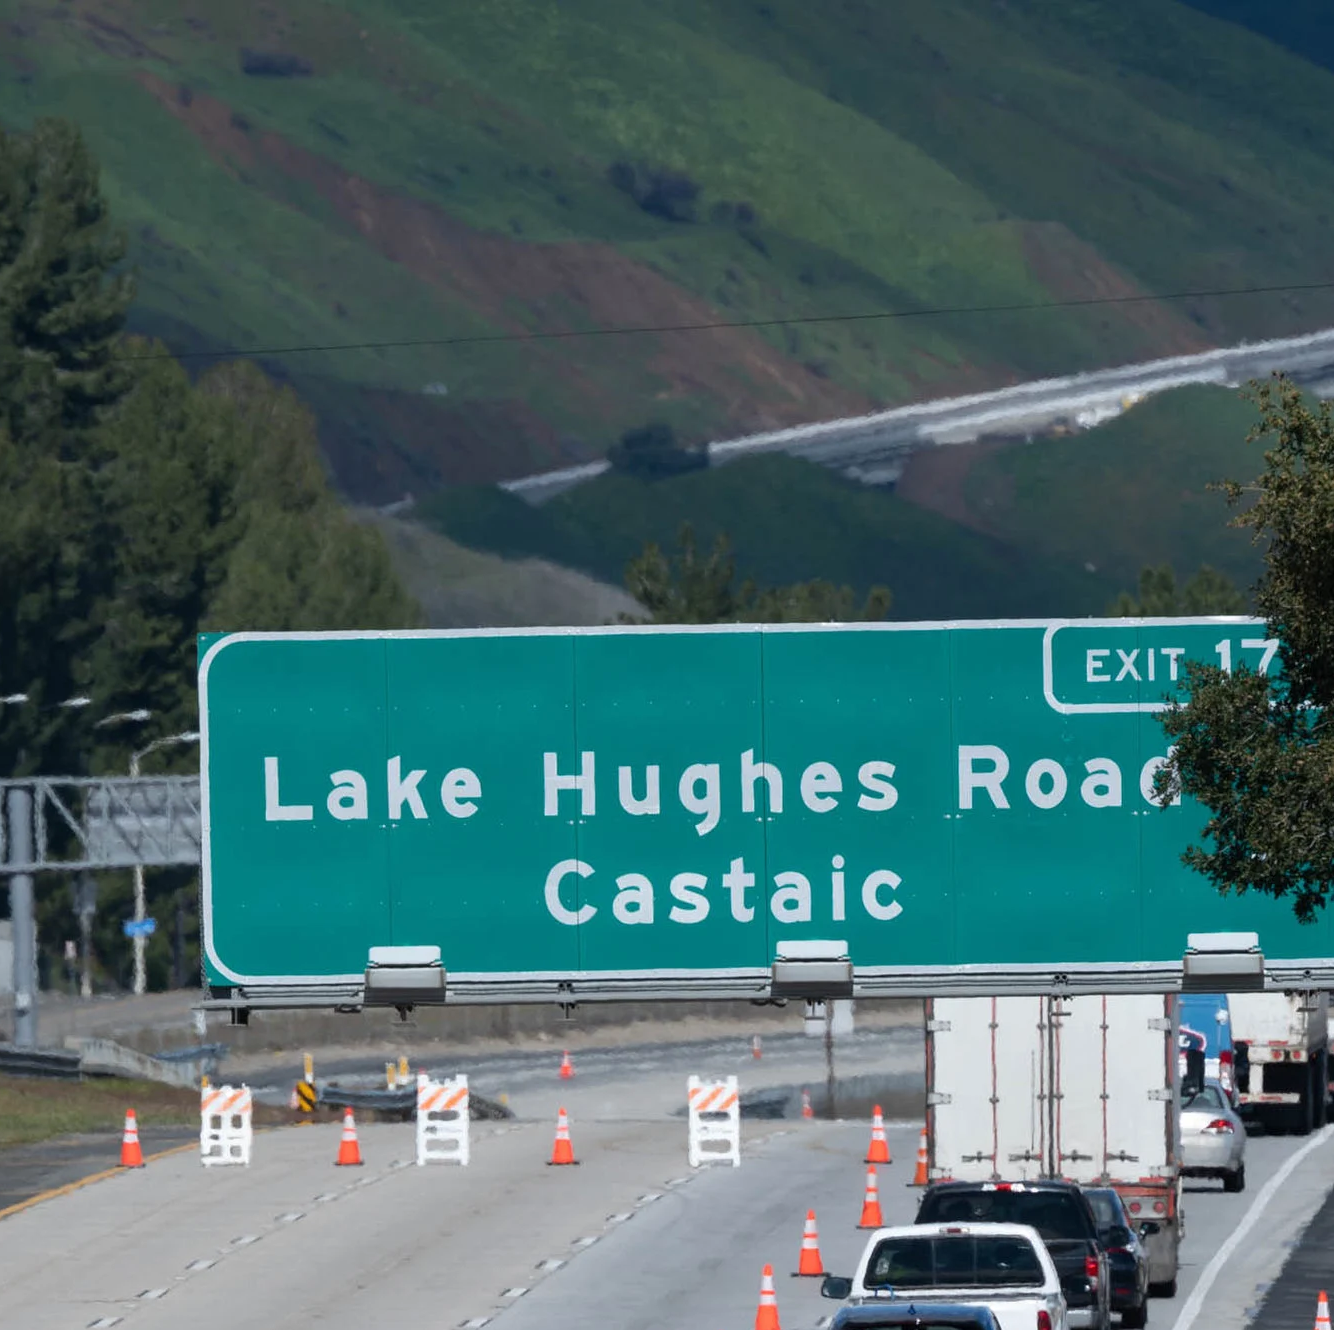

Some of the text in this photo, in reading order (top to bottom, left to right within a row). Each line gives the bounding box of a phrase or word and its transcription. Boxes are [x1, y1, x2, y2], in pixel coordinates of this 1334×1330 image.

[1086, 647, 1186, 683] EXIT
[264, 744, 1182, 836] Lake Hughes Road
[544, 854, 903, 926] Castaic
